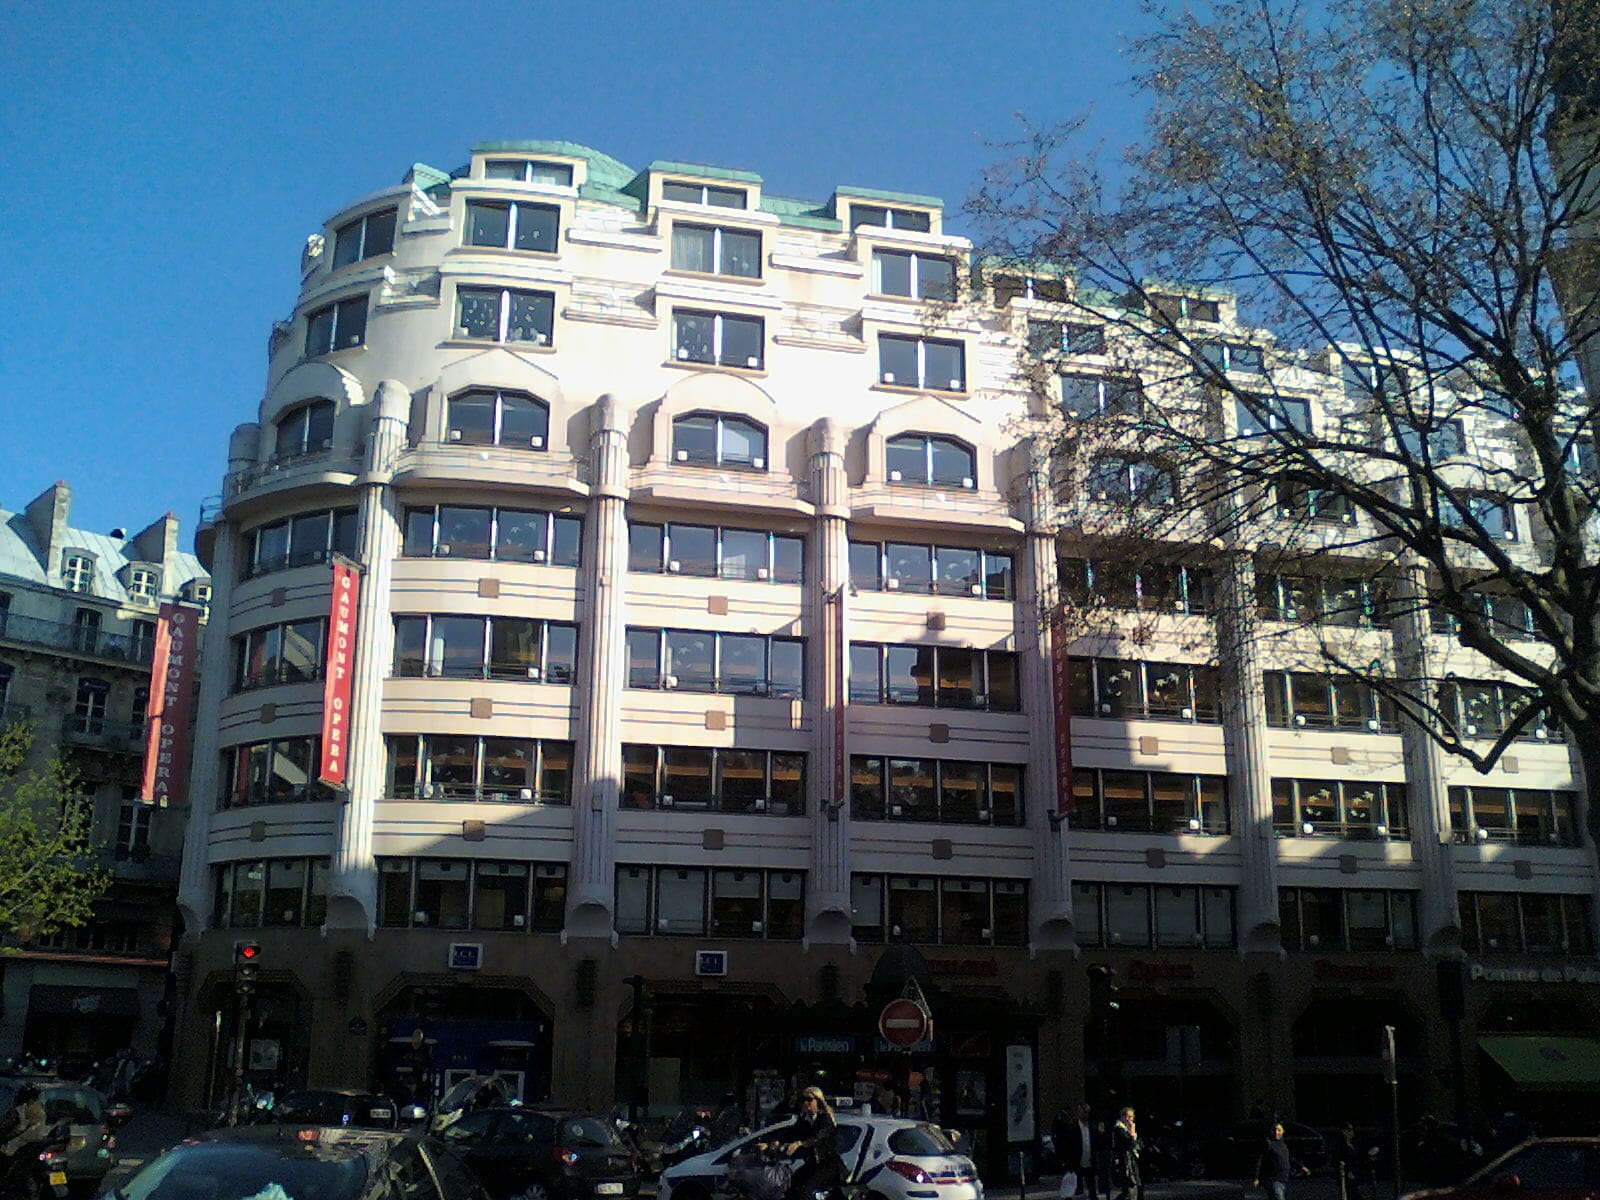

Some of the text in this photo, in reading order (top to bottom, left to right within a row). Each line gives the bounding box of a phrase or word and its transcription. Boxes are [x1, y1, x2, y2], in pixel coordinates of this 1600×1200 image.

[156, 612, 185, 793] GAUMONT OPERA
[329, 575, 350, 773] GAUMONT OPERA
